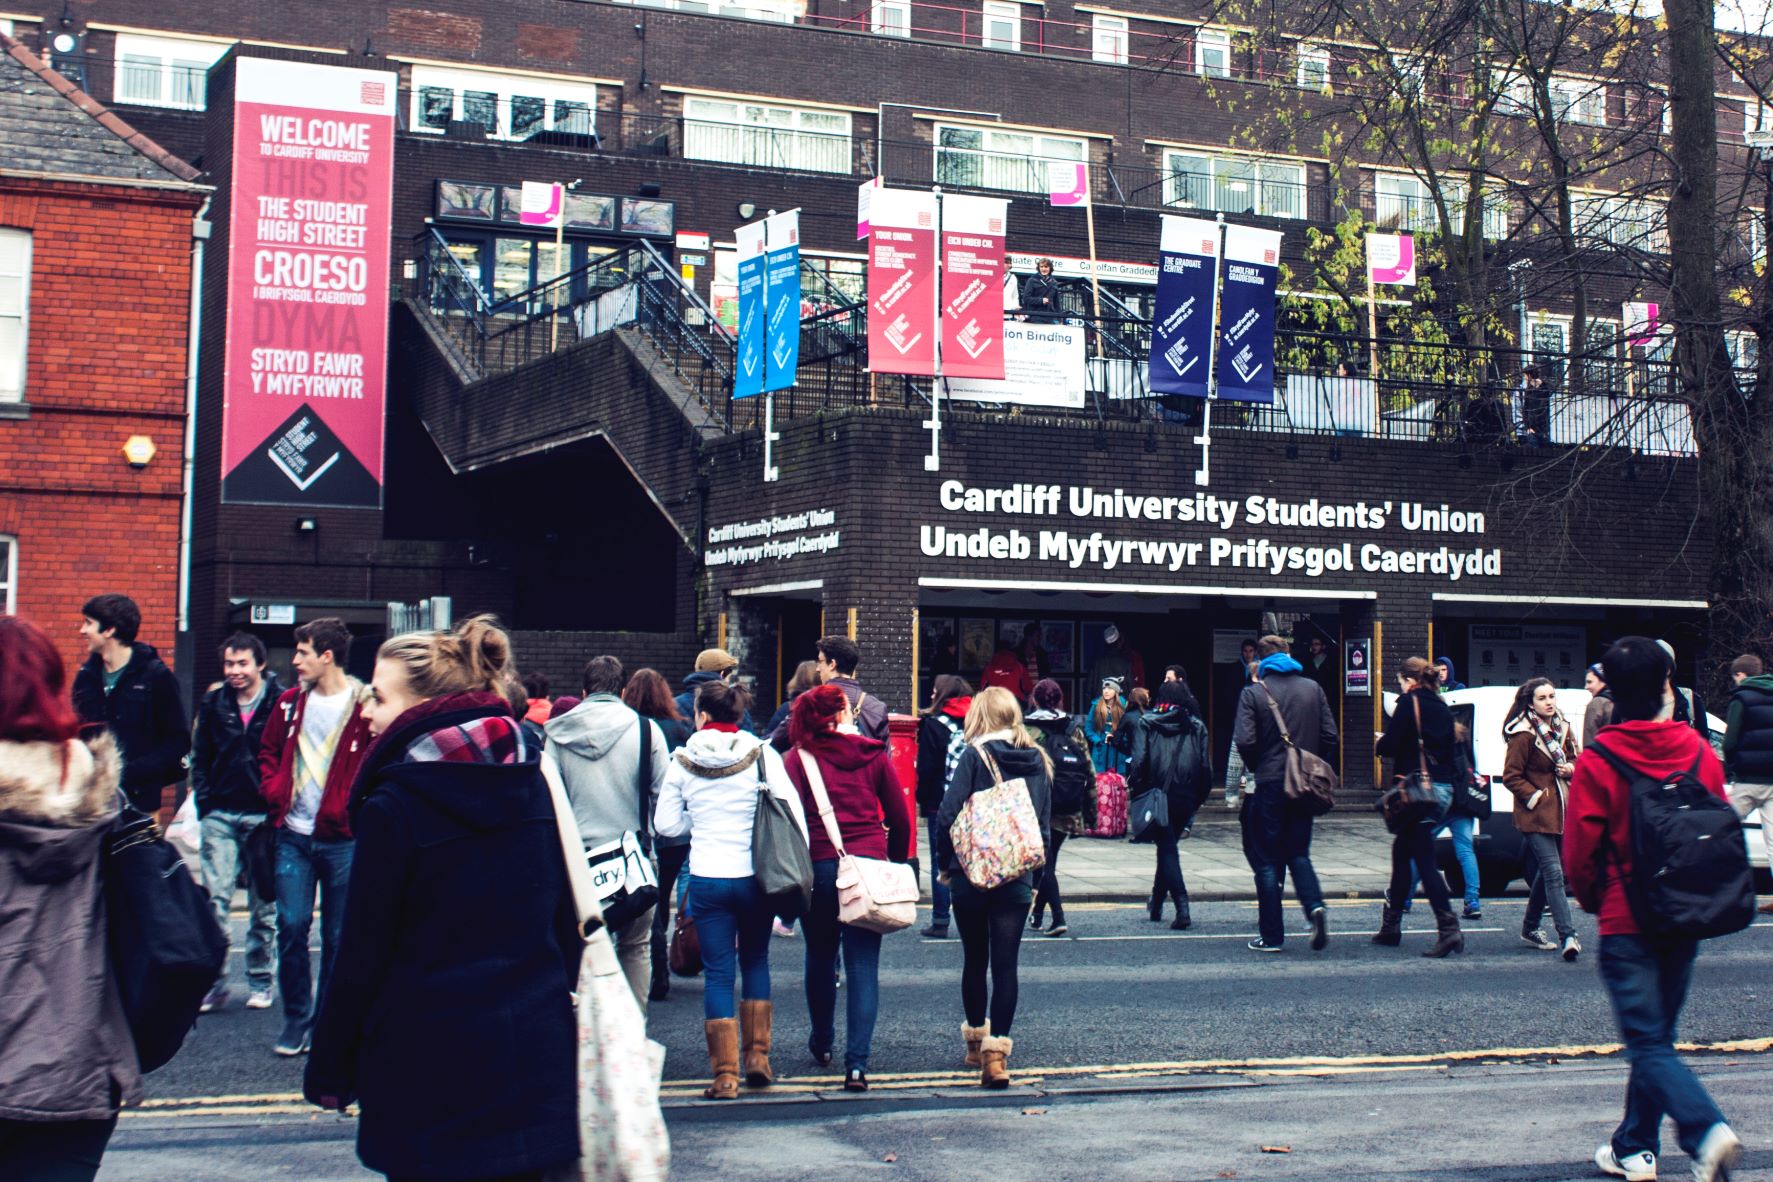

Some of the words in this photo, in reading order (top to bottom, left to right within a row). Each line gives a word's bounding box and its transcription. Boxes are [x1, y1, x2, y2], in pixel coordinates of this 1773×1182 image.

[260, 114, 371, 151] WELCOME
[259, 142, 273, 156] TO
[273, 144, 314, 159] CARDIFF
[315, 148, 369, 164] UNIVERSITY
[259, 157, 328, 199] THIS
[338, 164, 368, 202] IS
[257, 196, 291, 219] THE
[293, 198, 368, 225] STUDENT
[257, 218, 300, 243] HIGH
[303, 222, 367, 248] STREET
[254, 250, 367, 292] CROESO
[1079, 261, 1117, 273] Caolfan
[1163, 264, 1184, 275] CENTRE
[1164, 256, 1175, 266] THE
[1174, 257, 1202, 269] GRADUATE
[253, 286, 259, 299] I
[259, 286, 314, 303] BRIFYSGOL
[314, 289, 367, 306] CAERDYDD
[251, 300, 362, 352] DYMA
[1026, 330, 1073, 345] Binding
[251, 348, 309, 374] STRYD
[313, 352, 364, 377] FAWR
[251, 372, 264, 394] Y
[266, 374, 364, 400] MYFYRWYR
[939, 480, 1061, 515] Cardiff
[1069, 487, 1239, 530] University
[1245, 495, 1392, 530] Students'
[1401, 502, 1485, 533] Union
[708, 524, 734, 543] Cardiff
[733, 519, 772, 539] University
[810, 508, 835, 528] Union
[705, 549, 727, 566] Undeb
[727, 545, 764, 566] Myfyrwyr
[764, 536, 800, 560] Prifysgol
[800, 530, 840, 554] Caerdydd
[920, 526, 1031, 560] Undeb
[1039, 531, 1203, 571] Myfyrwyr
[1210, 538, 1353, 577] Prifysgol
[1360, 543, 1501, 581] Caerdydd
